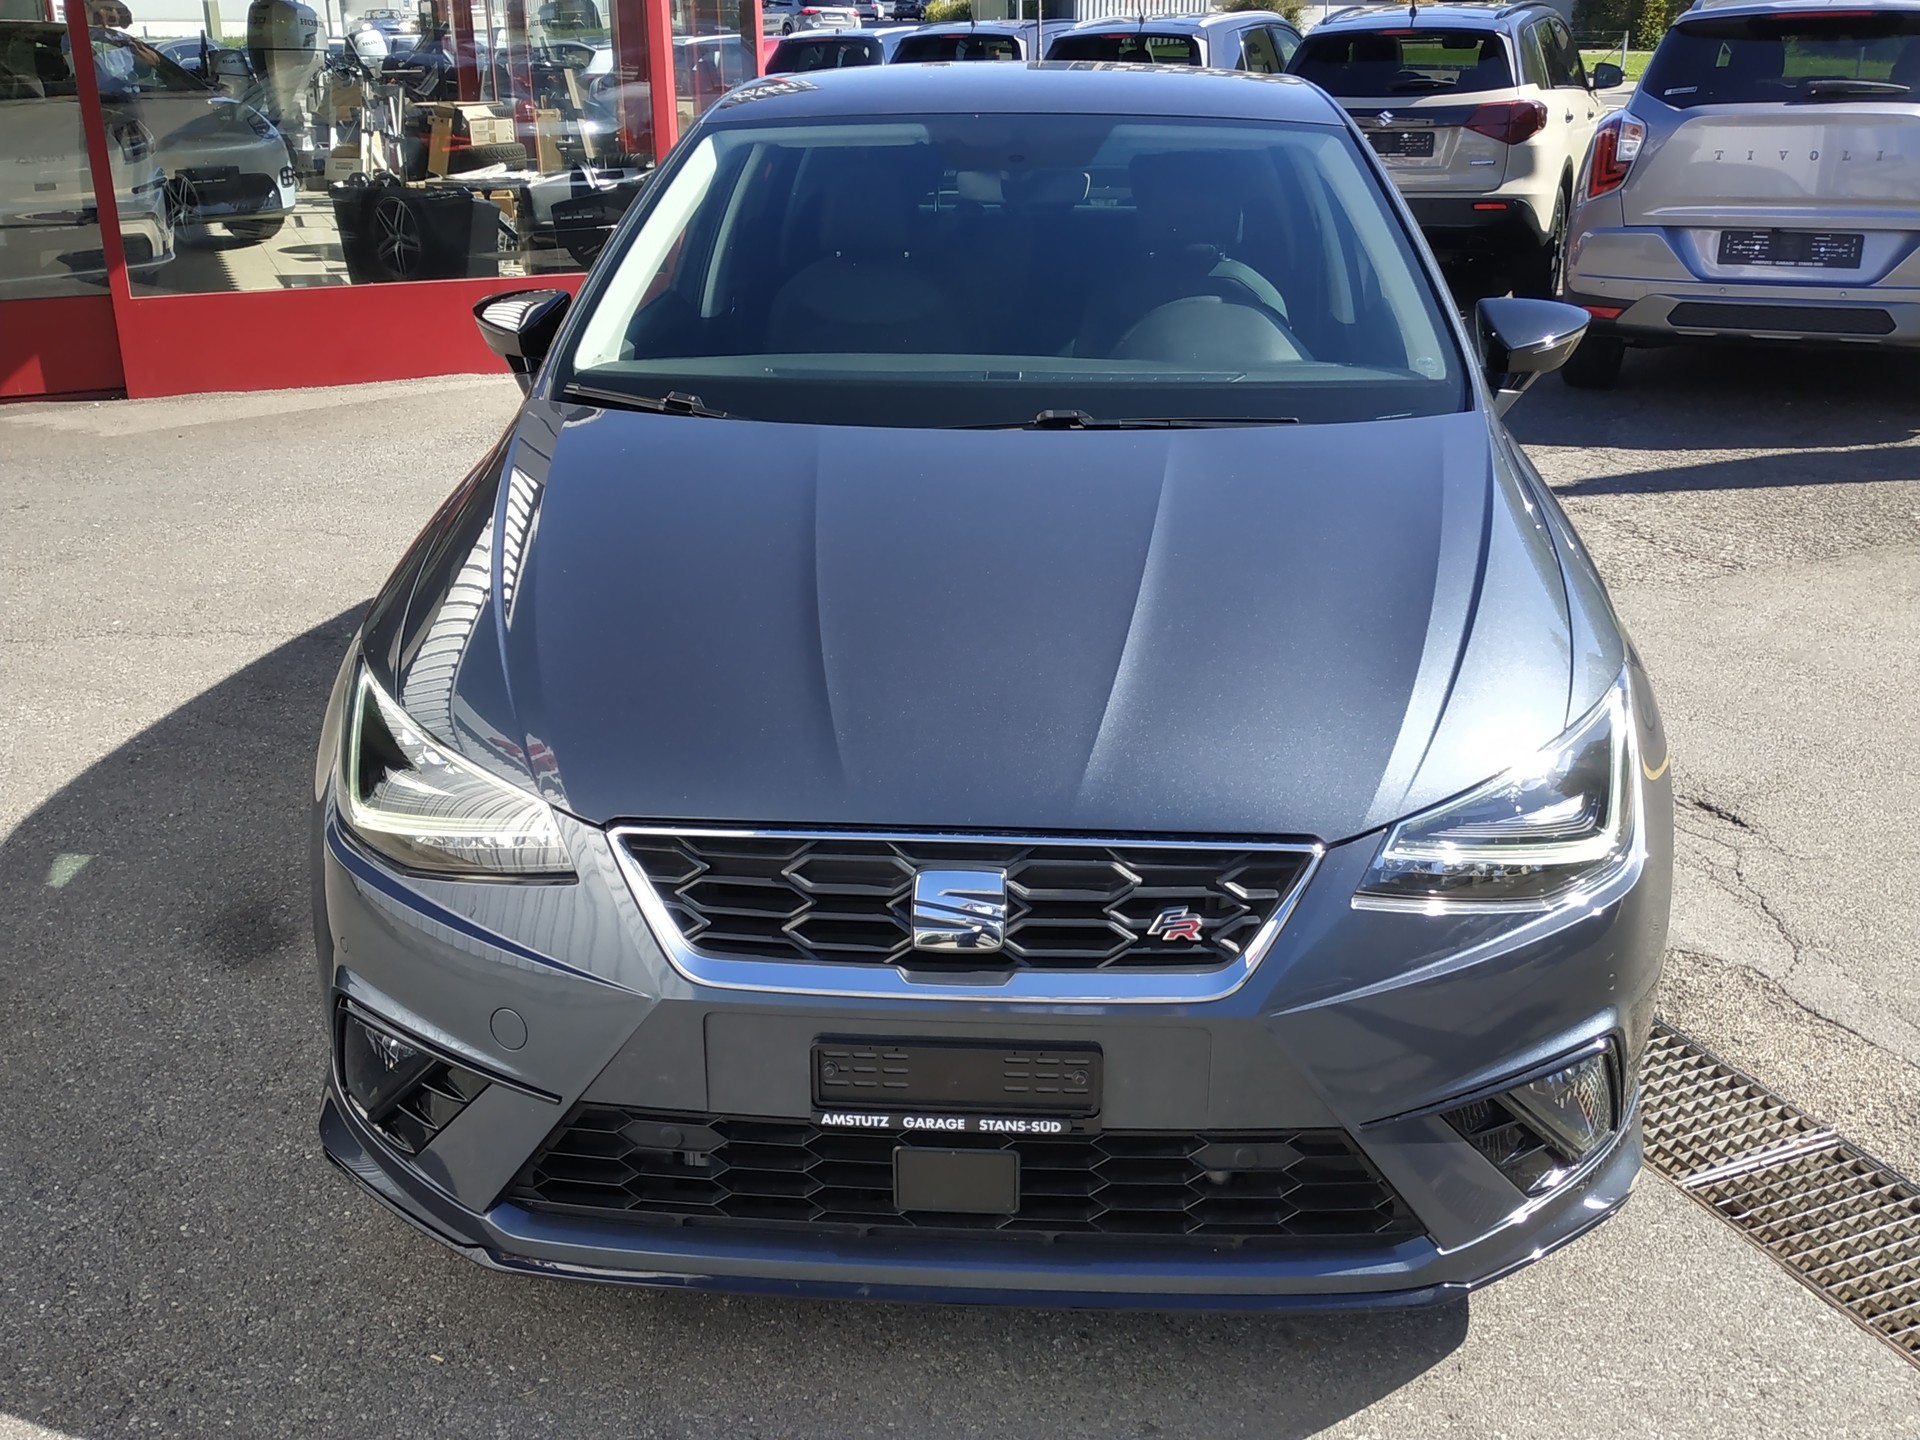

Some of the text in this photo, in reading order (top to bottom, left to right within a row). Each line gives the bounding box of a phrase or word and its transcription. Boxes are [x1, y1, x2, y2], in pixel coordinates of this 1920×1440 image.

[1714, 149, 1884, 162] TIVOLI
[1146, 905, 1203, 941] FR
[820, 1113, 1062, 1133] AMSTUTZ GARAGE STANS-SÜD
